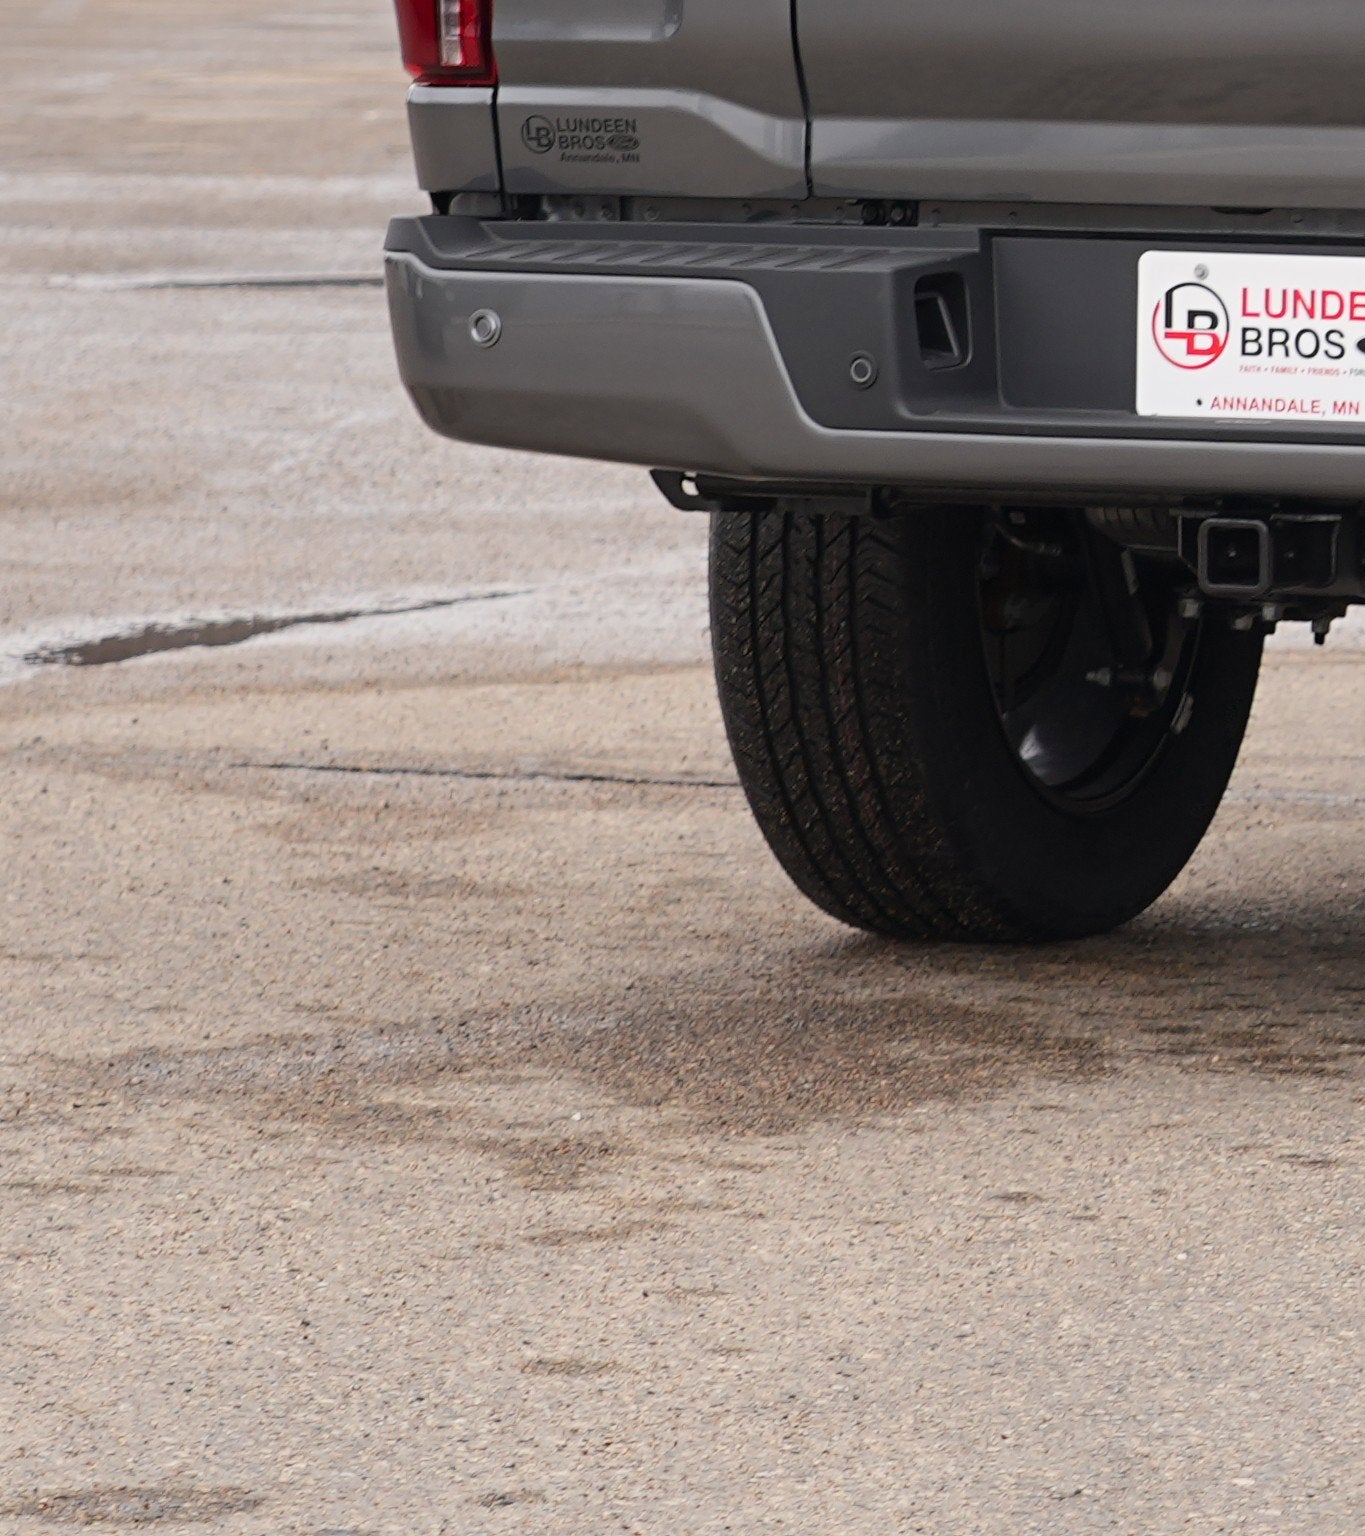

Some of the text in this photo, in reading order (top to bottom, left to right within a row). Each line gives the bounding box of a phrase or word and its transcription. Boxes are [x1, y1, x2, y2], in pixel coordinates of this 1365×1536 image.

[556, 117, 638, 133] LUNDEEN
[558, 135, 606, 150] BROS
[1240, 327, 1346, 360] BROS
[1210, 396, 1361, 416] ANNANDALE, MN
